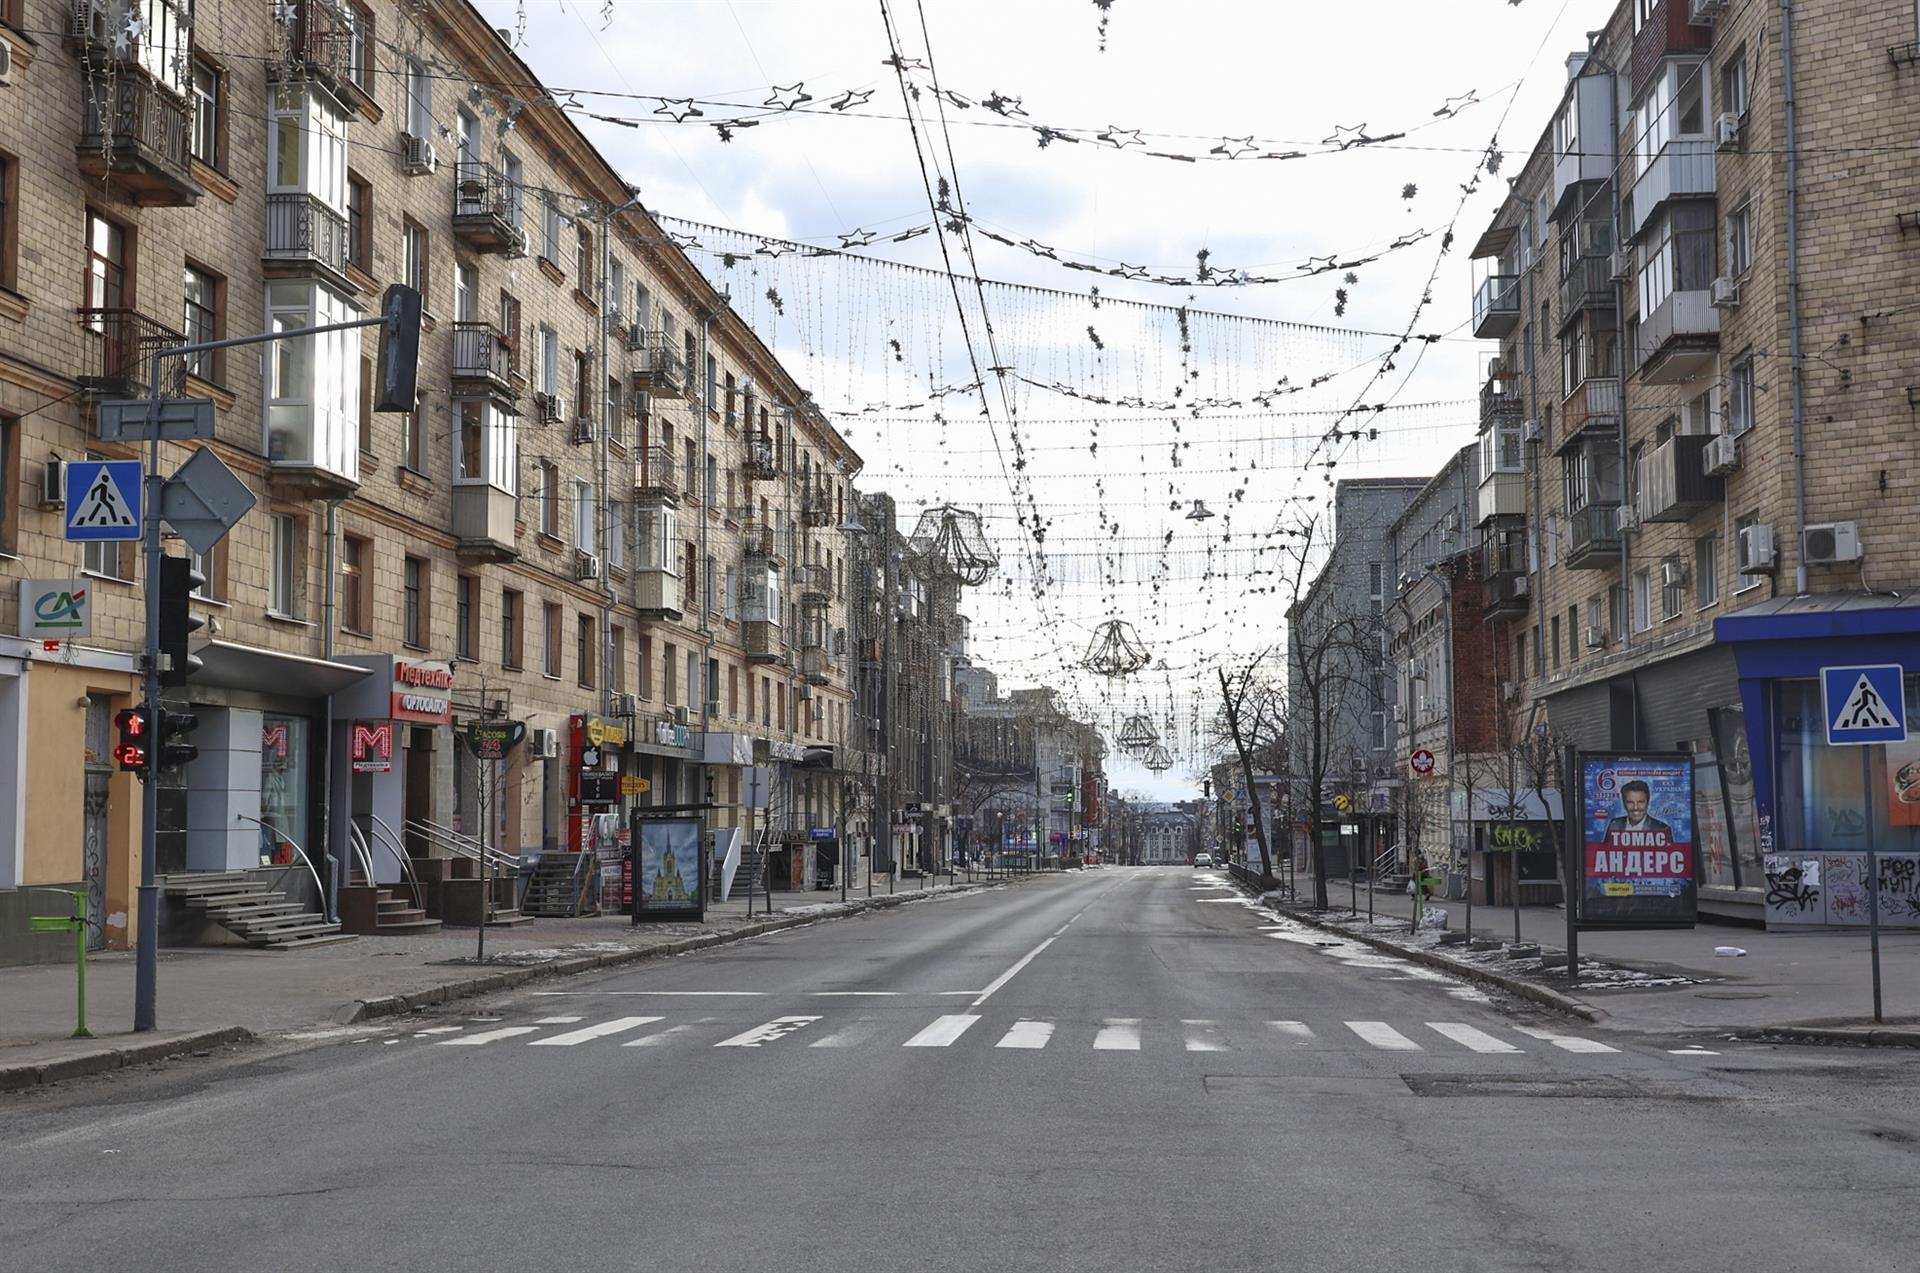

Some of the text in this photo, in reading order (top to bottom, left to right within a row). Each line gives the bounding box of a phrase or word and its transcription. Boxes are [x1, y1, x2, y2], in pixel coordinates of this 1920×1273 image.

[403, 695, 448, 714] ОРТОСАЛОН
[1597, 769, 1617, 791] 6
[1611, 832, 1666, 847] ТОМАС
[1594, 851, 1685, 876] АНДЕРС
